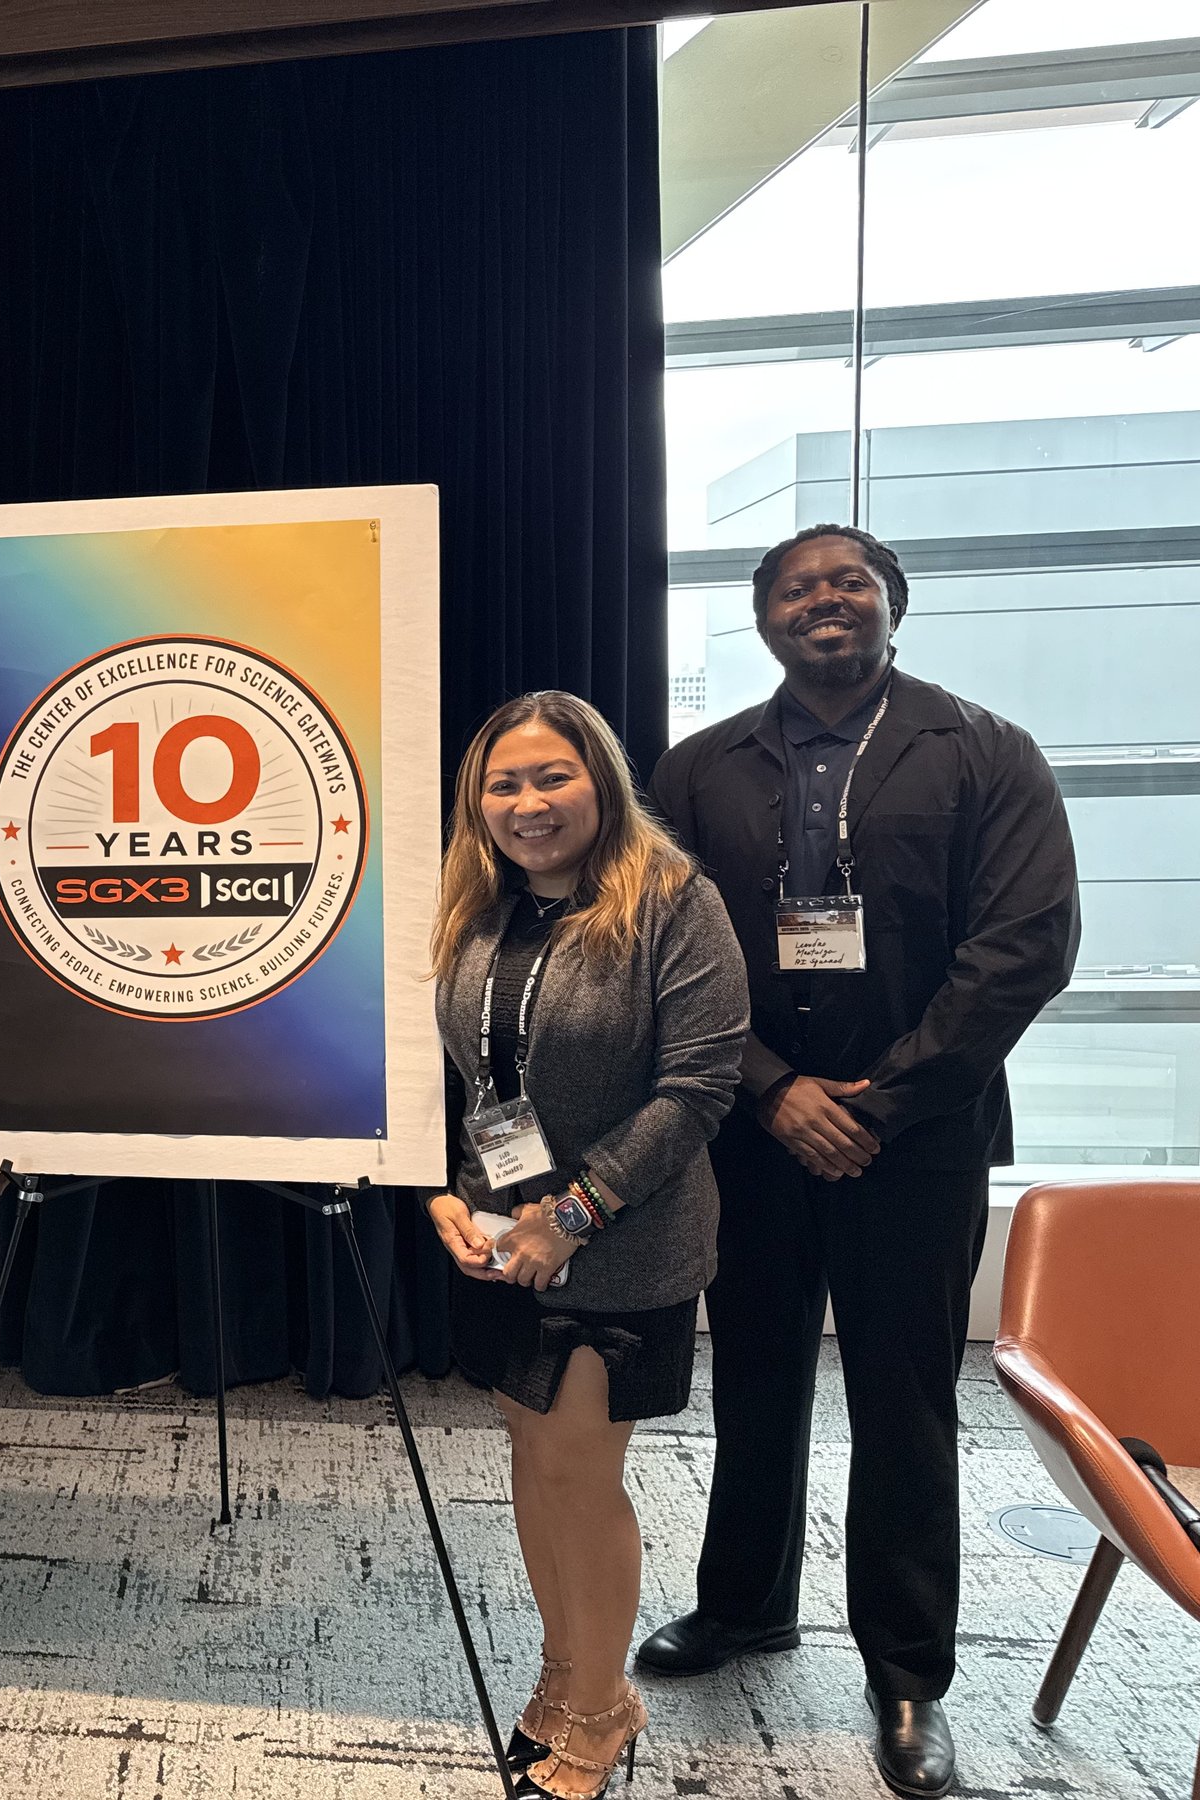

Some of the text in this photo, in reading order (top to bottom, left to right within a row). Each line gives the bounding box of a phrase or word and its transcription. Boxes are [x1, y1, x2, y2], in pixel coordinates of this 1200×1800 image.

[10, 653, 346, 794] THE CENTER OF EXCELLENCE FOR SCIENCE GATEWAYS
[90, 715, 261, 825] 10
[94, 829, 253, 858] YEARS
[56, 877, 190, 904] SGX3
[11, 871, 346, 1003] CONNECTING PEOPLE. EMPOWERING SCIENCE. BUILDING FUTURES.
[481, 977, 494, 1035] OnDemand
[519, 977, 535, 1035] OnDemand
